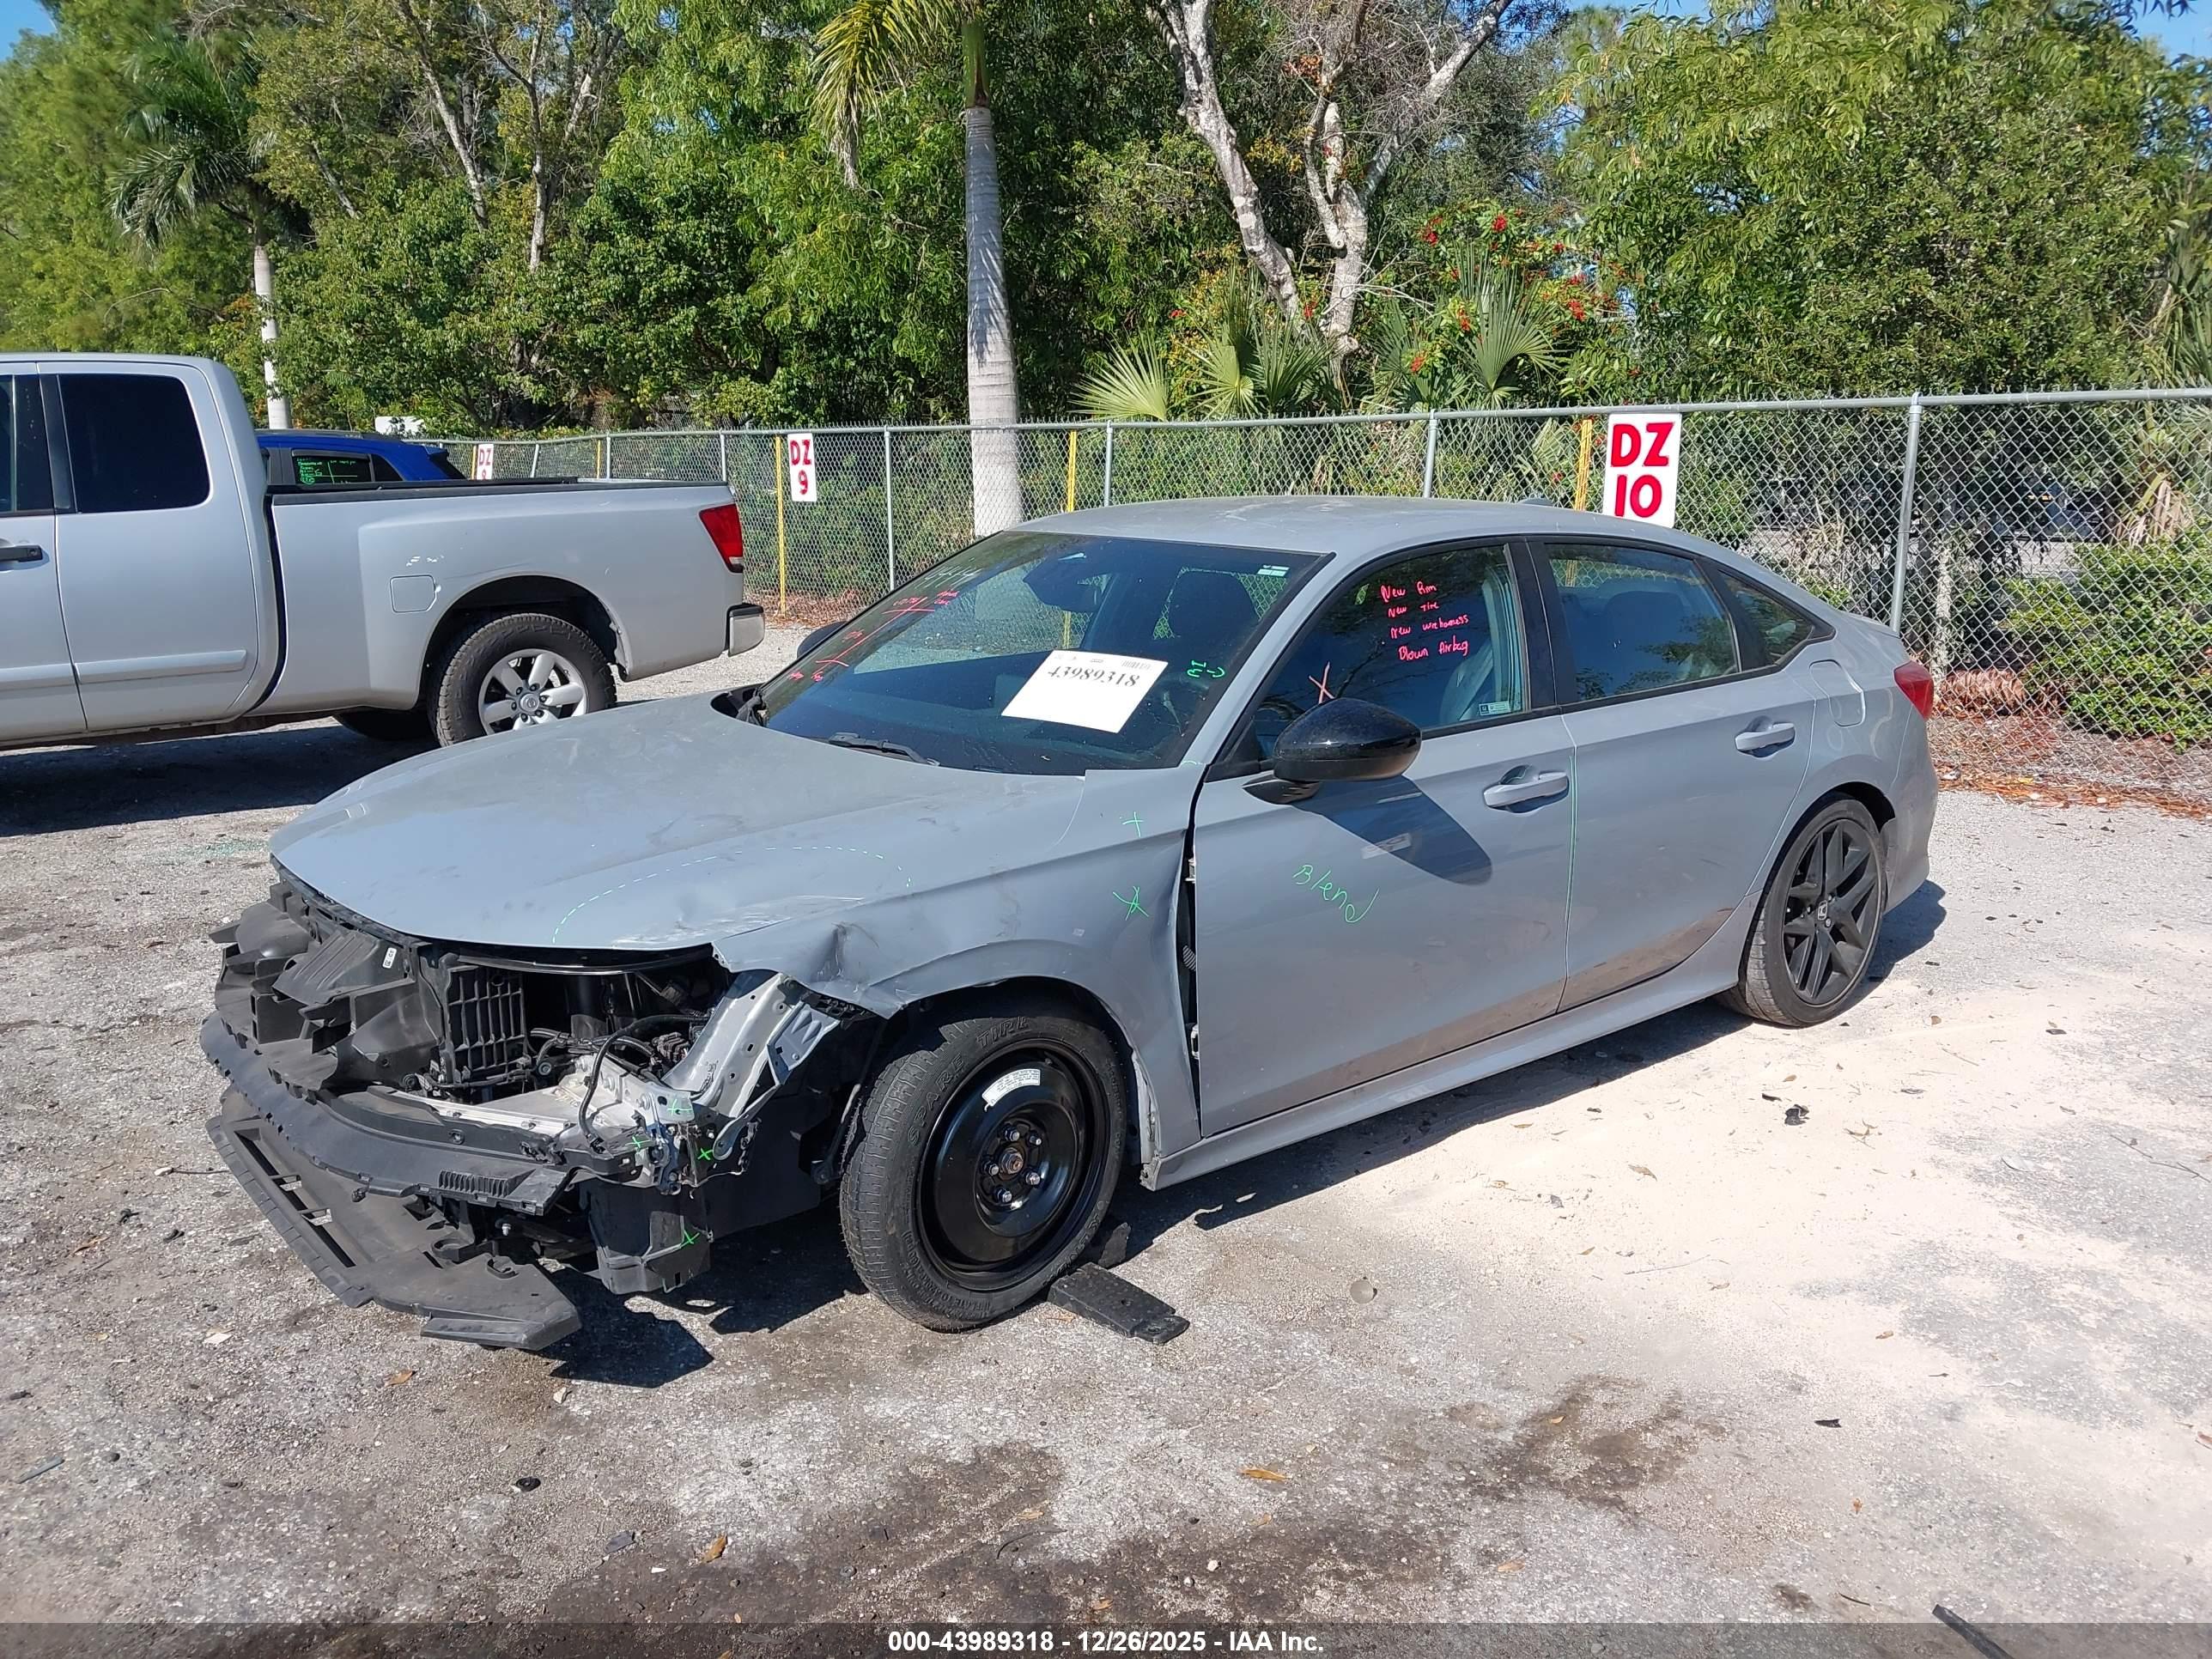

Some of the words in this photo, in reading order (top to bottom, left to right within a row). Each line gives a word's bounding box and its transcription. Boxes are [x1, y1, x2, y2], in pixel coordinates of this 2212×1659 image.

[478, 447, 492, 466] DZ
[790, 439, 811, 465] DZ
[1611, 422, 1675, 467] DZ
[798, 469, 809, 495] 9
[1614, 474, 1662, 518] 10
[1381, 585, 1406, 603] New
[1390, 626, 1411, 639] New
[1438, 635, 1468, 656] Airbag
[1048, 665, 1140, 687] 43989318
[1292, 864, 1380, 923] Blend
[908, 1053, 964, 1146] SPARE
[976, 1017, 1030, 1049] TIRE
